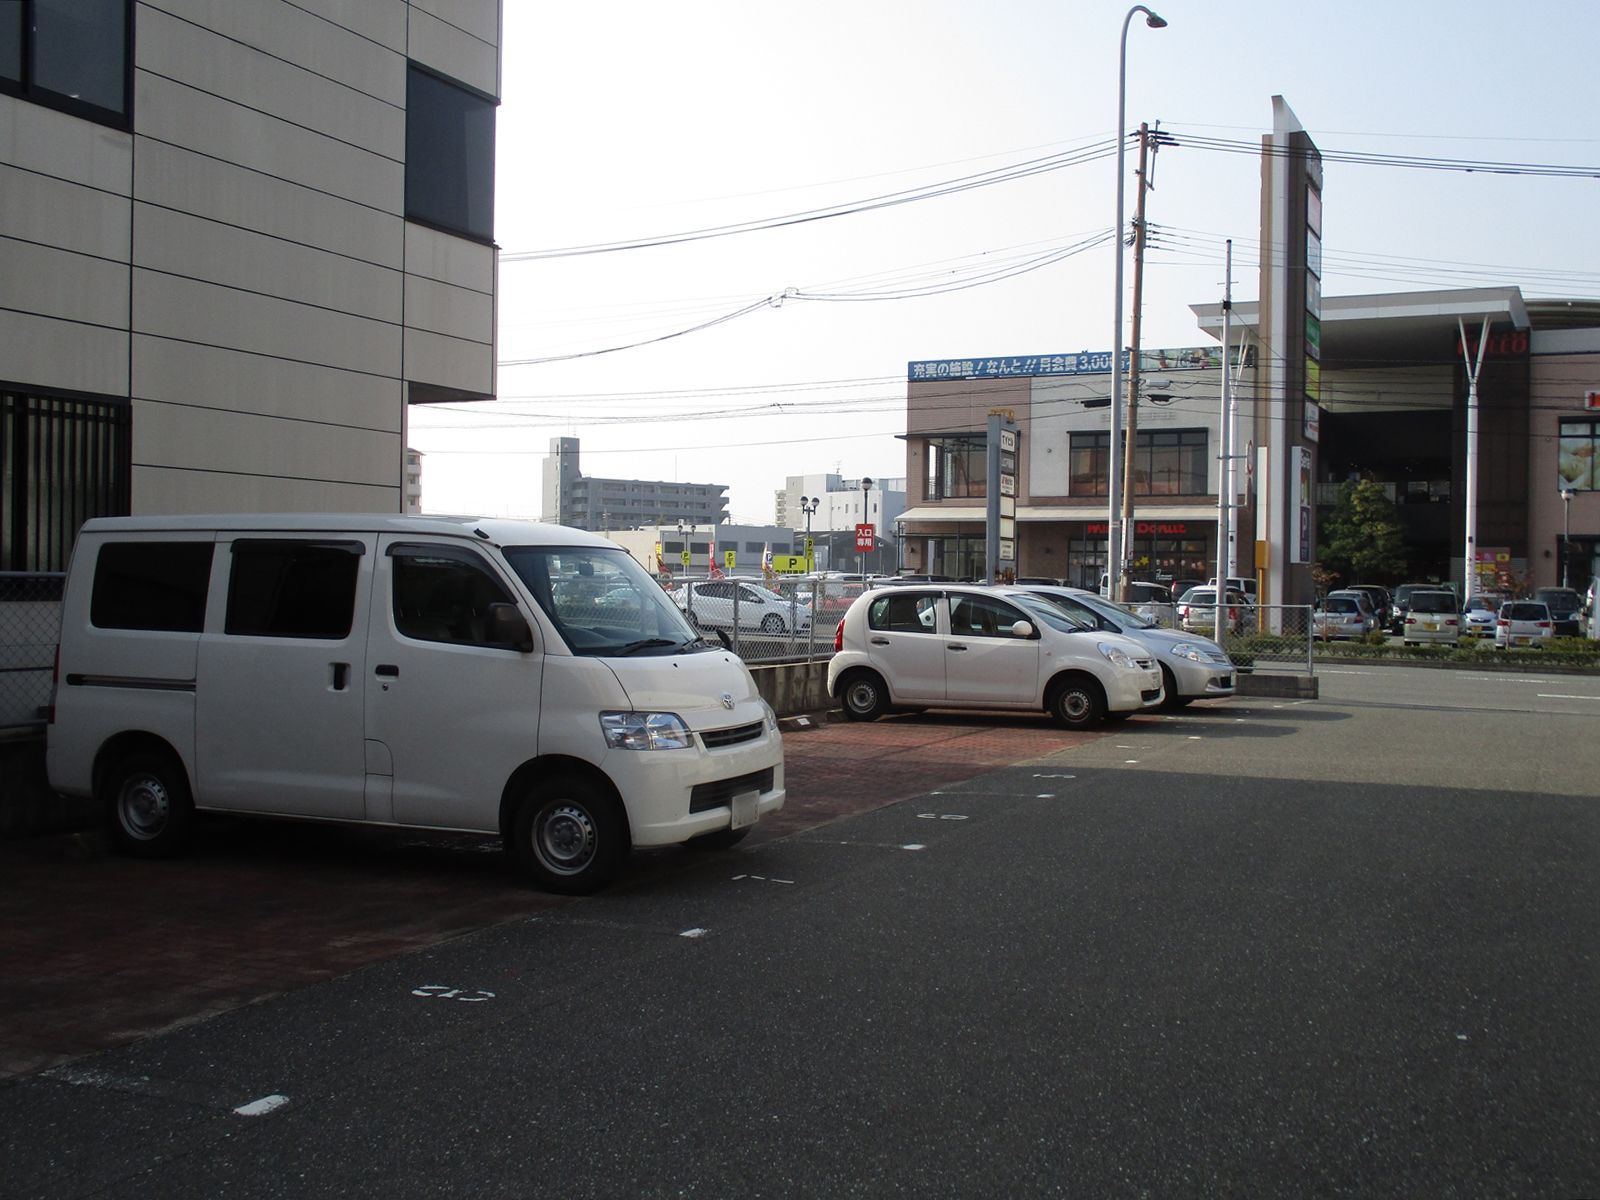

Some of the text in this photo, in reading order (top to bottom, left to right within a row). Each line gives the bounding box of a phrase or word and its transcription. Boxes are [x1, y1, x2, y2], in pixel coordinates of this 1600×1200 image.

[857, 528, 872, 537] 入口
[857, 538, 872, 546] 専用
[789, 558, 797, 568] P
